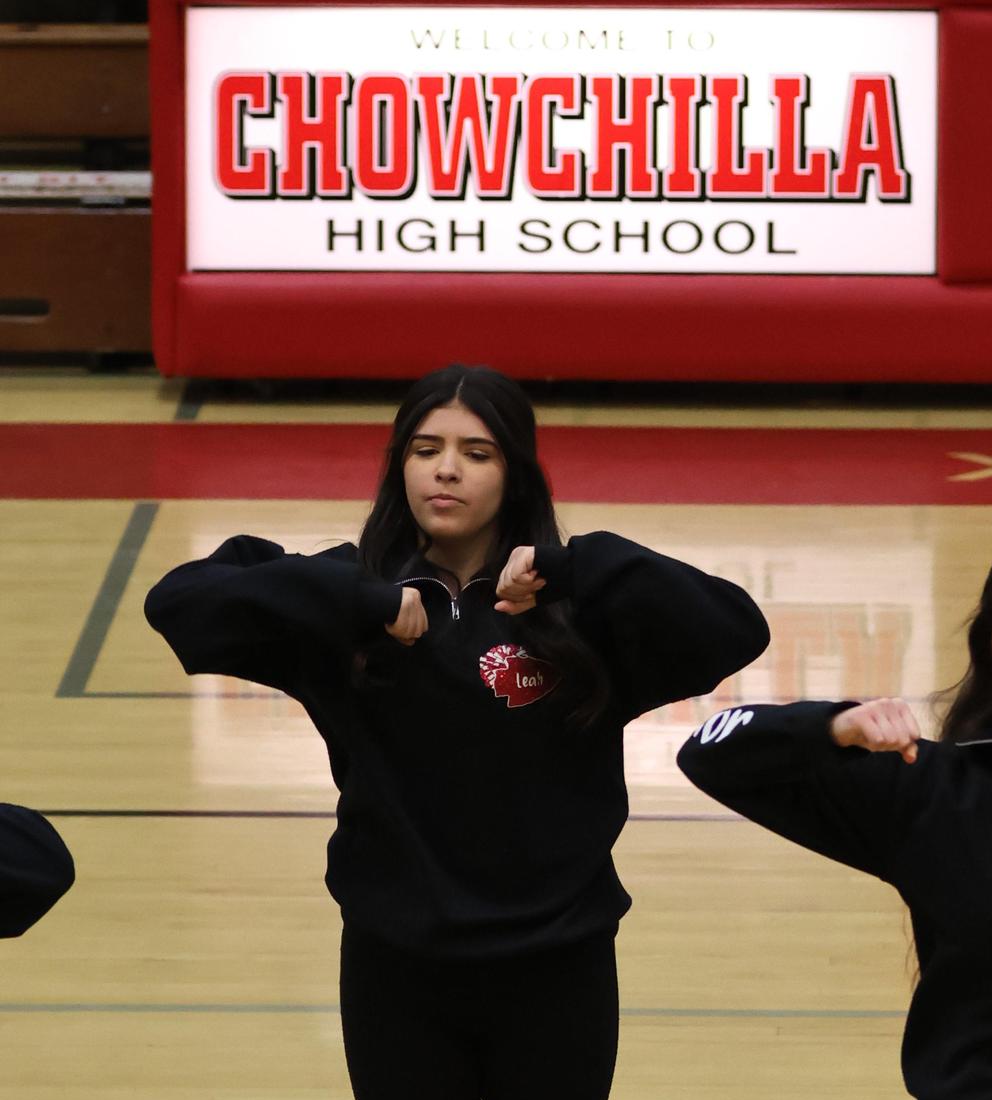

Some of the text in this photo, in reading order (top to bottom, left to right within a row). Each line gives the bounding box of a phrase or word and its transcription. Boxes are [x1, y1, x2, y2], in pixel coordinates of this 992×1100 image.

[410, 28, 716, 50] WELCOME TO
[214, 68, 913, 204] CHOWCHILLA
[326, 218, 798, 255] HIGH SCHOOL
